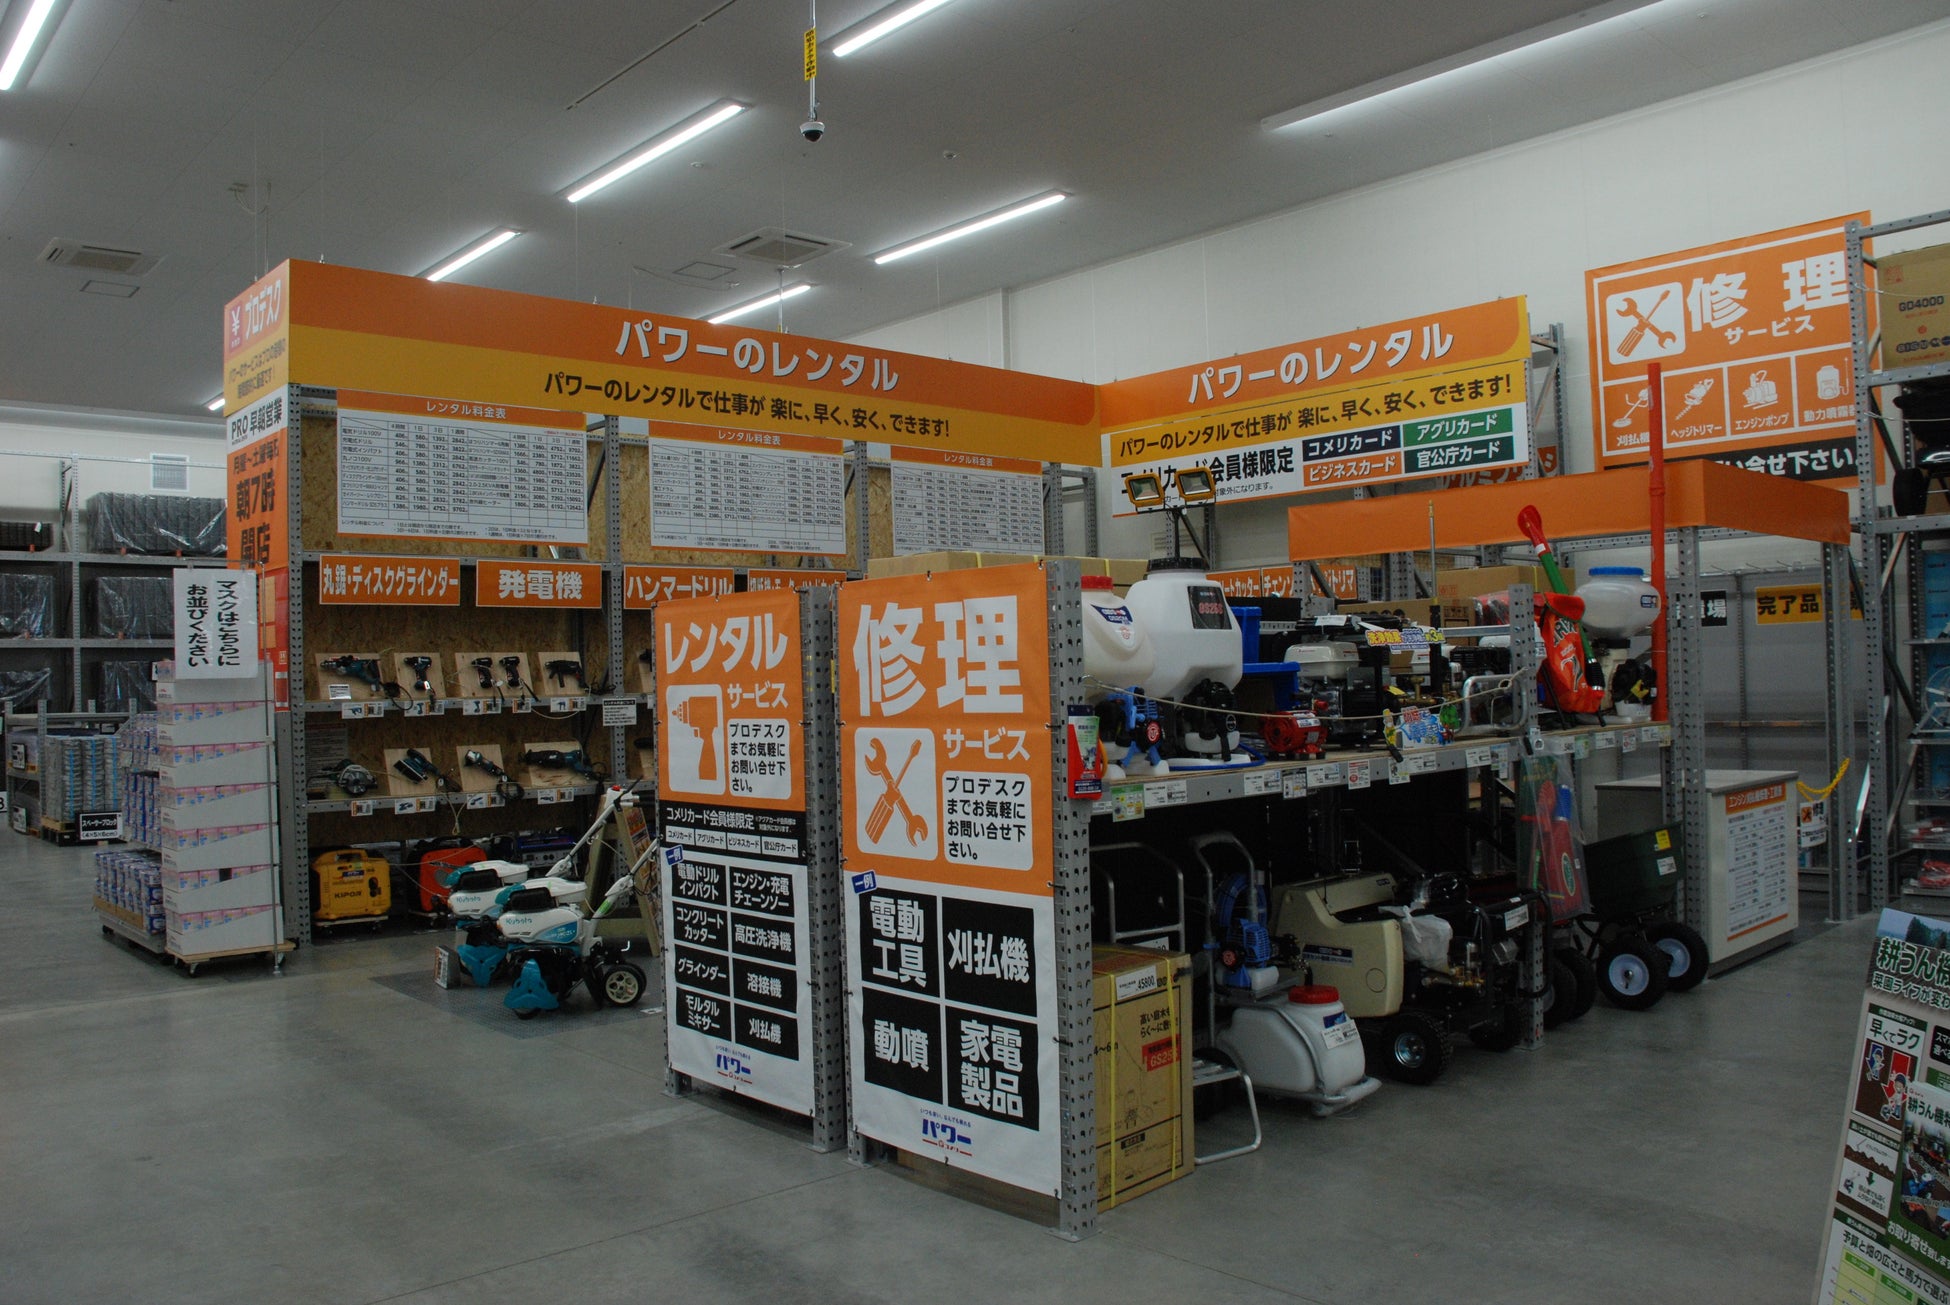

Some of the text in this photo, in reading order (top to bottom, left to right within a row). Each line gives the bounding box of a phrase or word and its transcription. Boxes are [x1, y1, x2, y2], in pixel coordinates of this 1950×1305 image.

[1686, 250, 1849, 333] 修理
[243, 278, 282, 340] プロデスク
[1724, 315, 1815, 345] サービス
[614, 317, 900, 392] パワーのレンタル
[1187, 322, 1454, 404] パワーのレンタル
[544, 371, 766, 418] パワーのレンタルで仕事が
[425, 400, 508, 421] レンタル料金表
[1734, 412, 1790, 432] エンジンポンプ
[231, 415, 248, 441] PRO
[717, 428, 782, 447] レンタル料金表
[1119, 411, 1292, 458] パワーのレンタルで仕事が
[1415, 414, 1499, 443] アグリカード
[1670, 425, 1724, 439] ヘッジトリマー
[1307, 430, 1393, 457] コメリカード
[1416, 441, 1502, 470] 官公庁カード
[943, 451, 995, 468] レンタル料金表
[1307, 455, 1397, 482] ビジネスカード
[240, 521, 270, 570] 開店
[498, 568, 583, 601] 発電機
[626, 573, 733, 601] ハンマードリル
[1757, 593, 1820, 616] 完了品
[186, 583, 209, 668] お並びください
[216, 580, 241, 667] マスクはこちらに
[664, 612, 789, 674] レンタル
[852, 594, 1024, 718] 修理
[726, 680, 789, 709] サービス
[730, 722, 785, 739] プロデスク
[943, 726, 1031, 761] サービス
[730, 742, 786, 758] までお気軽に
[731, 760, 786, 777] お問い合せ下
[731, 777, 753, 793] さい。
[945, 776, 1026, 798] プロデスク
[666, 806, 756, 831] コメリカード会員様限定
[946, 798, 1027, 820] までお気軽に
[667, 829, 797, 853] コメリカード アグリカード ビジネスカード 官公庁カード
[947, 820, 1027, 843] お問い合せ下
[948, 841, 979, 861] さい。
[677, 862, 720, 884] 電動ドリル
[732, 871, 790, 896] エンジン・充電
[854, 873, 874, 891] 一例
[679, 882, 720, 900] インパクト
[734, 889, 790, 911] チェーンソー
[676, 907, 725, 928] コンクリート
[869, 895, 925, 943] 電動
[684, 925, 718, 942] カッター
[734, 923, 792, 953] 高圧洗浄機
[677, 957, 728, 981] グラインダー
[872, 939, 928, 988] 工具
[947, 929, 1031, 985] 刈払機
[747, 972, 783, 999] 溶接機
[685, 995, 721, 1017] モルタル
[687, 1012, 721, 1032] ミキサー
[748, 1018, 782, 1045] 刈払機
[1869, 1018, 1920, 1050] 早くてラク
[873, 1018, 930, 1073] 動噴
[960, 1019, 1023, 1072] 家電
[716, 1053, 752, 1075] パワー
[960, 1062, 1024, 1119] 製品
[922, 1118, 972, 1145] パワー
